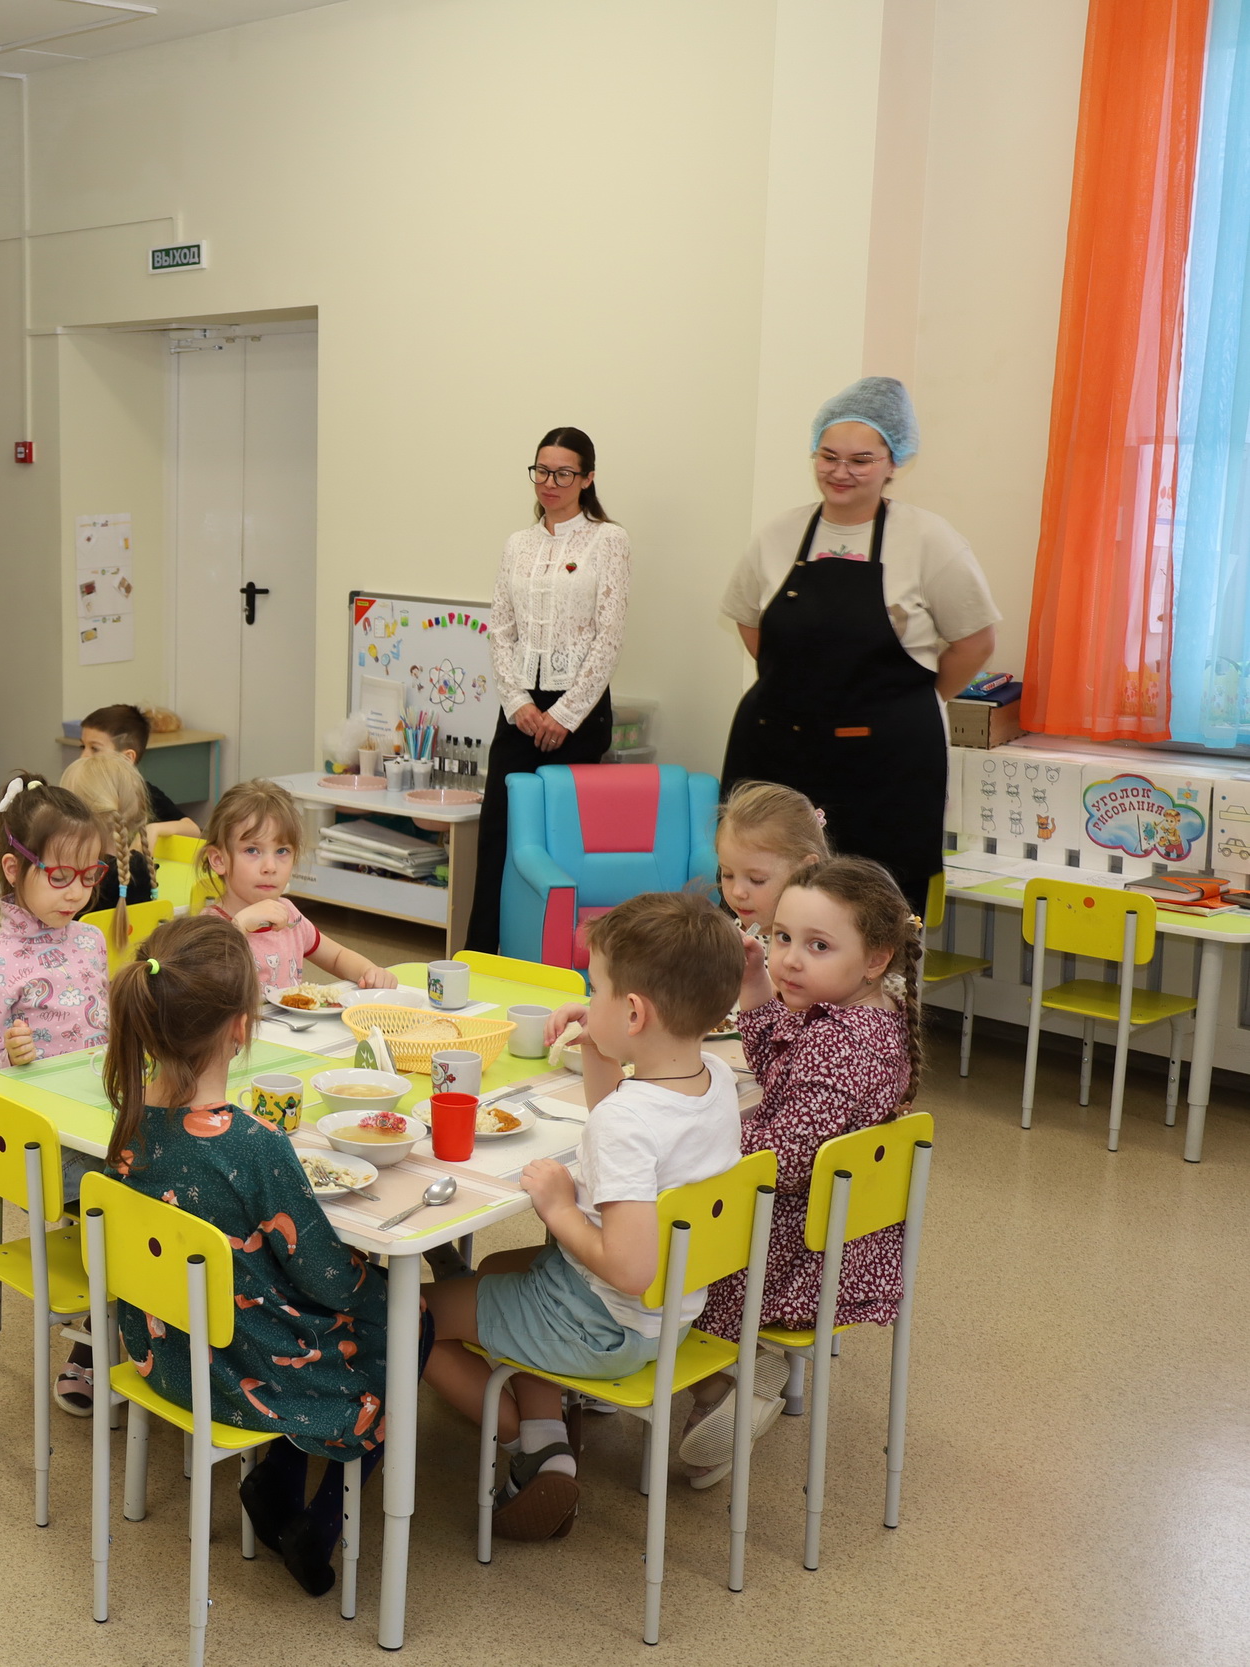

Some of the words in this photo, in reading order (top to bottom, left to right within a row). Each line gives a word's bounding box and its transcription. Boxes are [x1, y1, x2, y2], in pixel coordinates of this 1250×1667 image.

[154, 247, 199, 267] ВЫХОД
[421, 612, 491, 640] ЛАБАРАТОР
[1091, 787, 1152, 812] УГОЛОК
[1092, 800, 1165, 832] РИСОВАНИЯ
